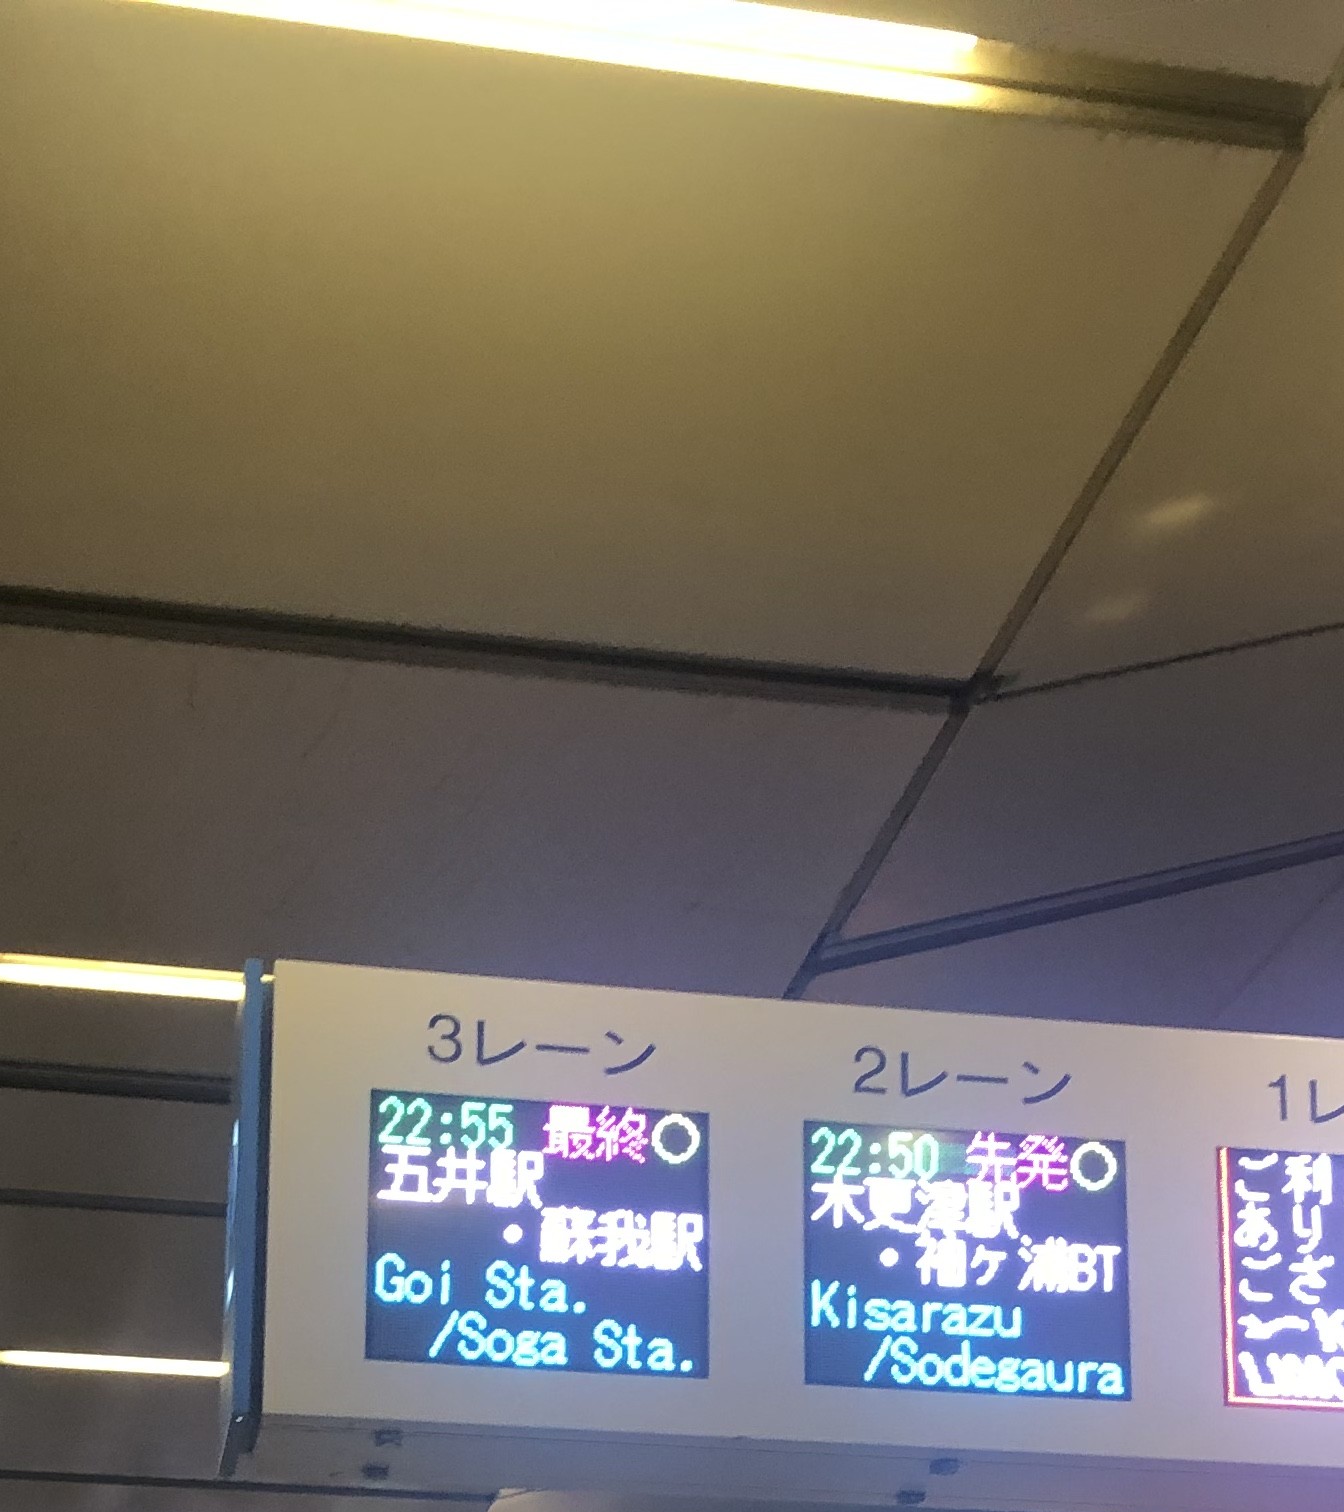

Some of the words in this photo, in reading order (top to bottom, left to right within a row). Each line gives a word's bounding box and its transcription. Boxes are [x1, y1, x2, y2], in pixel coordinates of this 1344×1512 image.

[426, 1012, 657, 1075] 3レーン
[853, 1046, 1071, 1104] 2レーン
[377, 1095, 514, 1150] 22:55
[376, 1143, 545, 1210] 五井駅
[811, 1127, 940, 1178] 22:50
[810, 1177, 1022, 1240] 木更津駅
[373, 1252, 453, 1307] Goi
[484, 1260, 587, 1315] Sta.
[810, 1280, 1024, 1336] Kisarazu
[593, 1318, 694, 1373] Sta.
